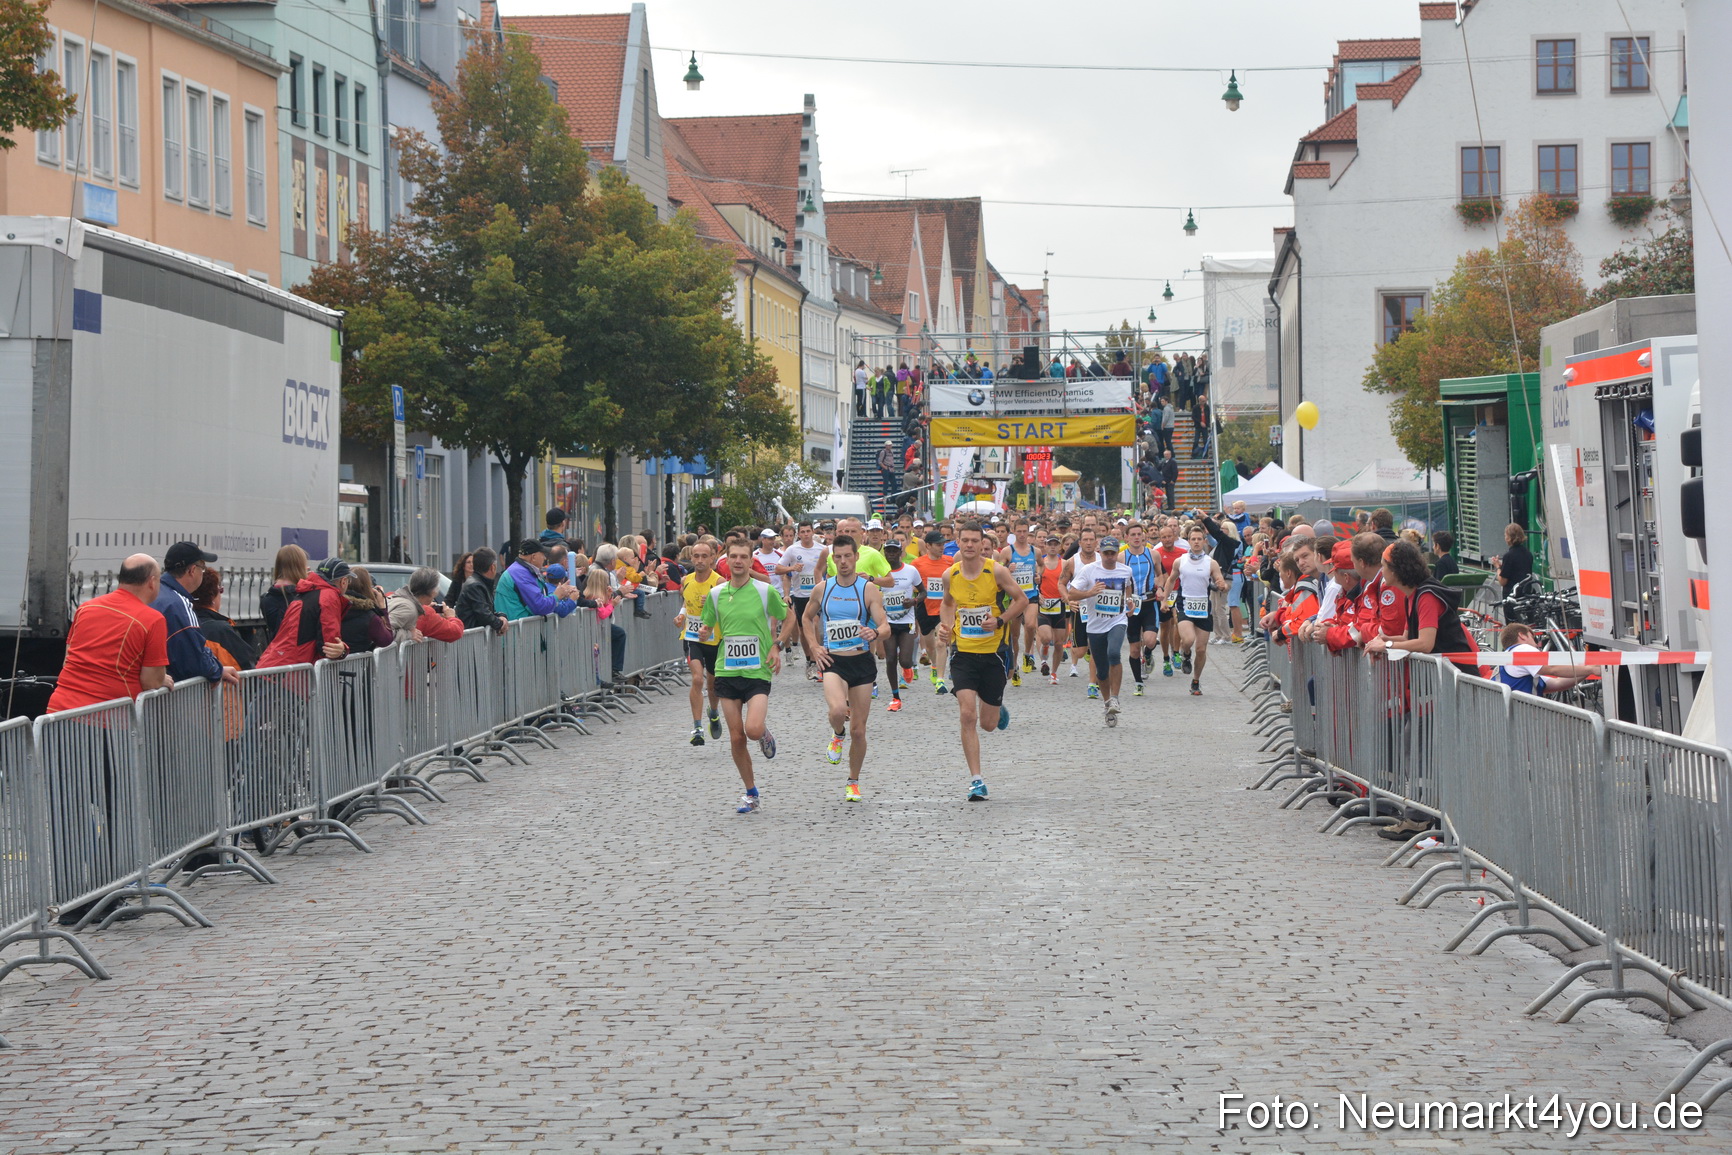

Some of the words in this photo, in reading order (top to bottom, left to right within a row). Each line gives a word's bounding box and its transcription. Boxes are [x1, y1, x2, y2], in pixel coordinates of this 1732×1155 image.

[283, 379, 330, 450] BOCK
[998, 422, 1068, 440] START
[950, 480, 959, 500] Audi
[1098, 595, 1120, 606] 2013
[1188, 602, 1206, 610] 3376
[830, 626, 859, 640] 2002
[728, 644, 756, 657] 2000
